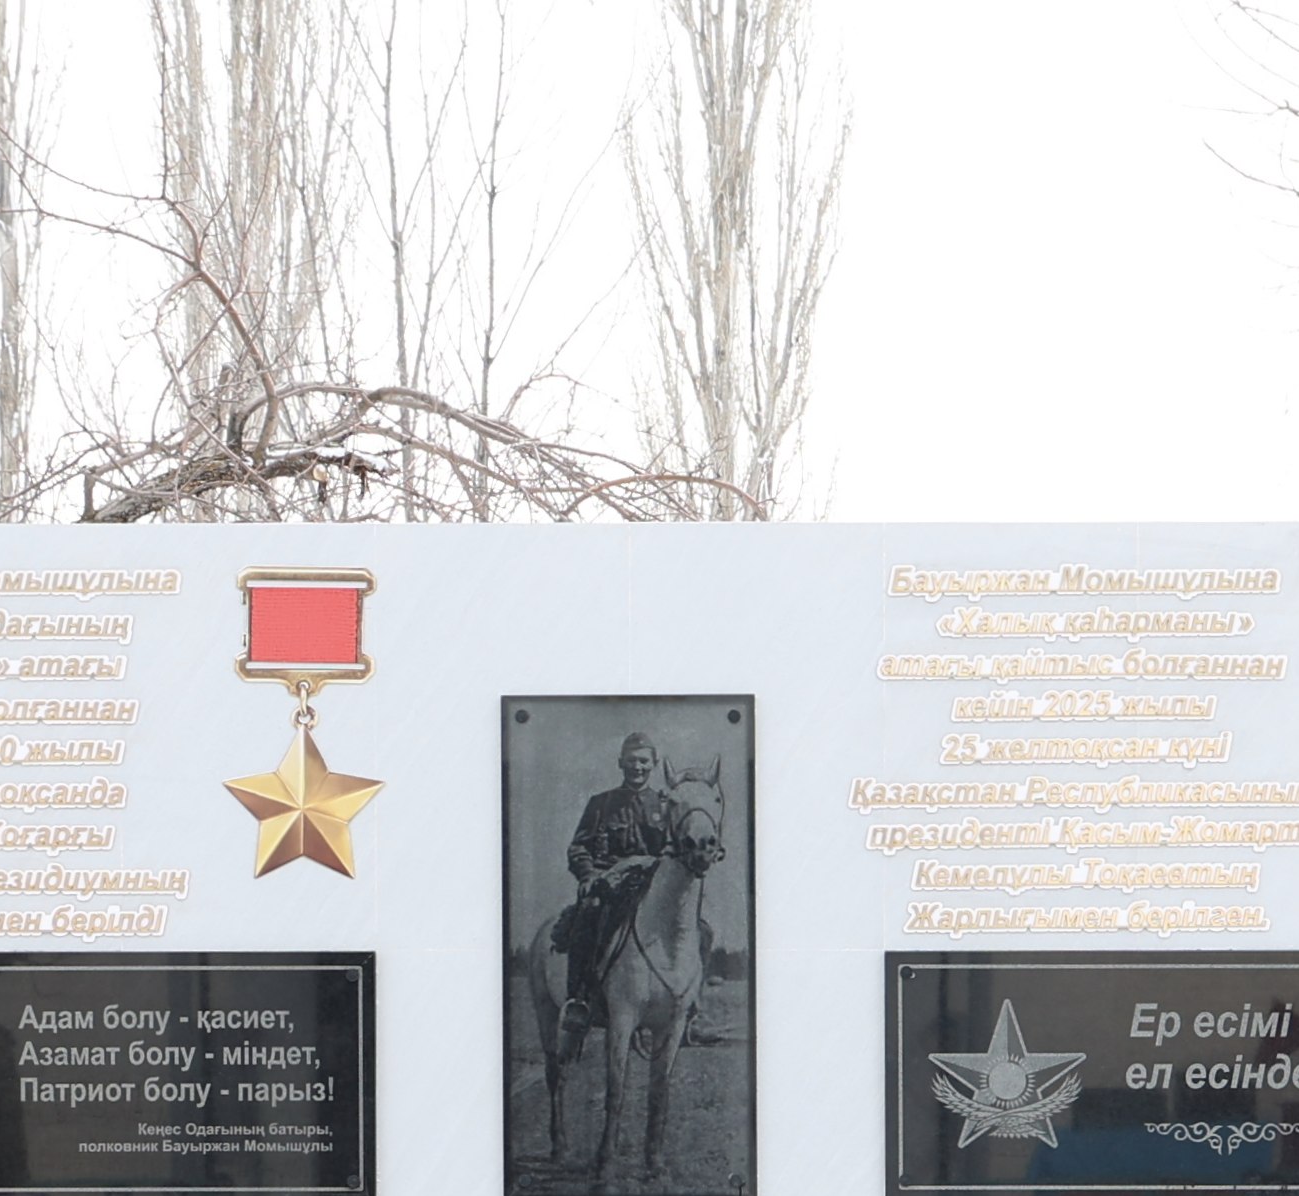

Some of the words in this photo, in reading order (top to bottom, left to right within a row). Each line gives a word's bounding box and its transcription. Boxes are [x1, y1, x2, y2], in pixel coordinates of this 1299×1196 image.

[891, 566, 1051, 599] Бауыржан
[1059, 566, 1279, 597] Момышұлына
[939, 608, 1055, 638] «Халық
[1065, 606, 1254, 639] қаһарманы»
[19, 656, 123, 678] атағы
[879, 655, 984, 678] атағы
[991, 649, 1113, 681] қайтыс
[1122, 649, 1286, 679] болғаннан
[953, 692, 1034, 719] кейін
[1044, 691, 1111, 718] 2025
[1121, 695, 1215, 719] жылы
[24, 742, 123, 763] жылы
[942, 735, 978, 763] 25
[985, 740, 1160, 766] желтоқсан
[1168, 732, 1231, 767] күні
[850, 779, 1018, 811] Қазақстан
[871, 819, 1052, 852] президенті
[1083, 858, 1258, 891] Тоқаевтың
[50, 905, 164, 937] берілді
[905, 903, 1119, 934] Жарлығымен
[1127, 901, 1268, 934] берілген.
[19, 1005, 93, 1033] Адам
[103, 1004, 170, 1035] болу
[198, 1011, 293, 1033] қасиет,
[1130, 1003, 1181, 1046] Ер
[1194, 1003, 1292, 1038] есімі
[19, 1041, 120, 1065] Азамат
[129, 1040, 195, 1071] болу
[223, 1041, 319, 1069] міндет,
[1126, 1063, 1173, 1089] ел
[21, 1078, 135, 1108] Патриот
[144, 1077, 211, 1107] болу
[238, 1077, 333, 1107] парыз!
[138, 1123, 181, 1137] Кеңес
[185, 1123, 266, 1137] Одағының
[269, 1123, 333, 1138] батыры,
[79, 1142, 159, 1153] полковник
[162, 1140, 240, 1155] Бауыржан
[244, 1140, 333, 1155] Момышұлы
